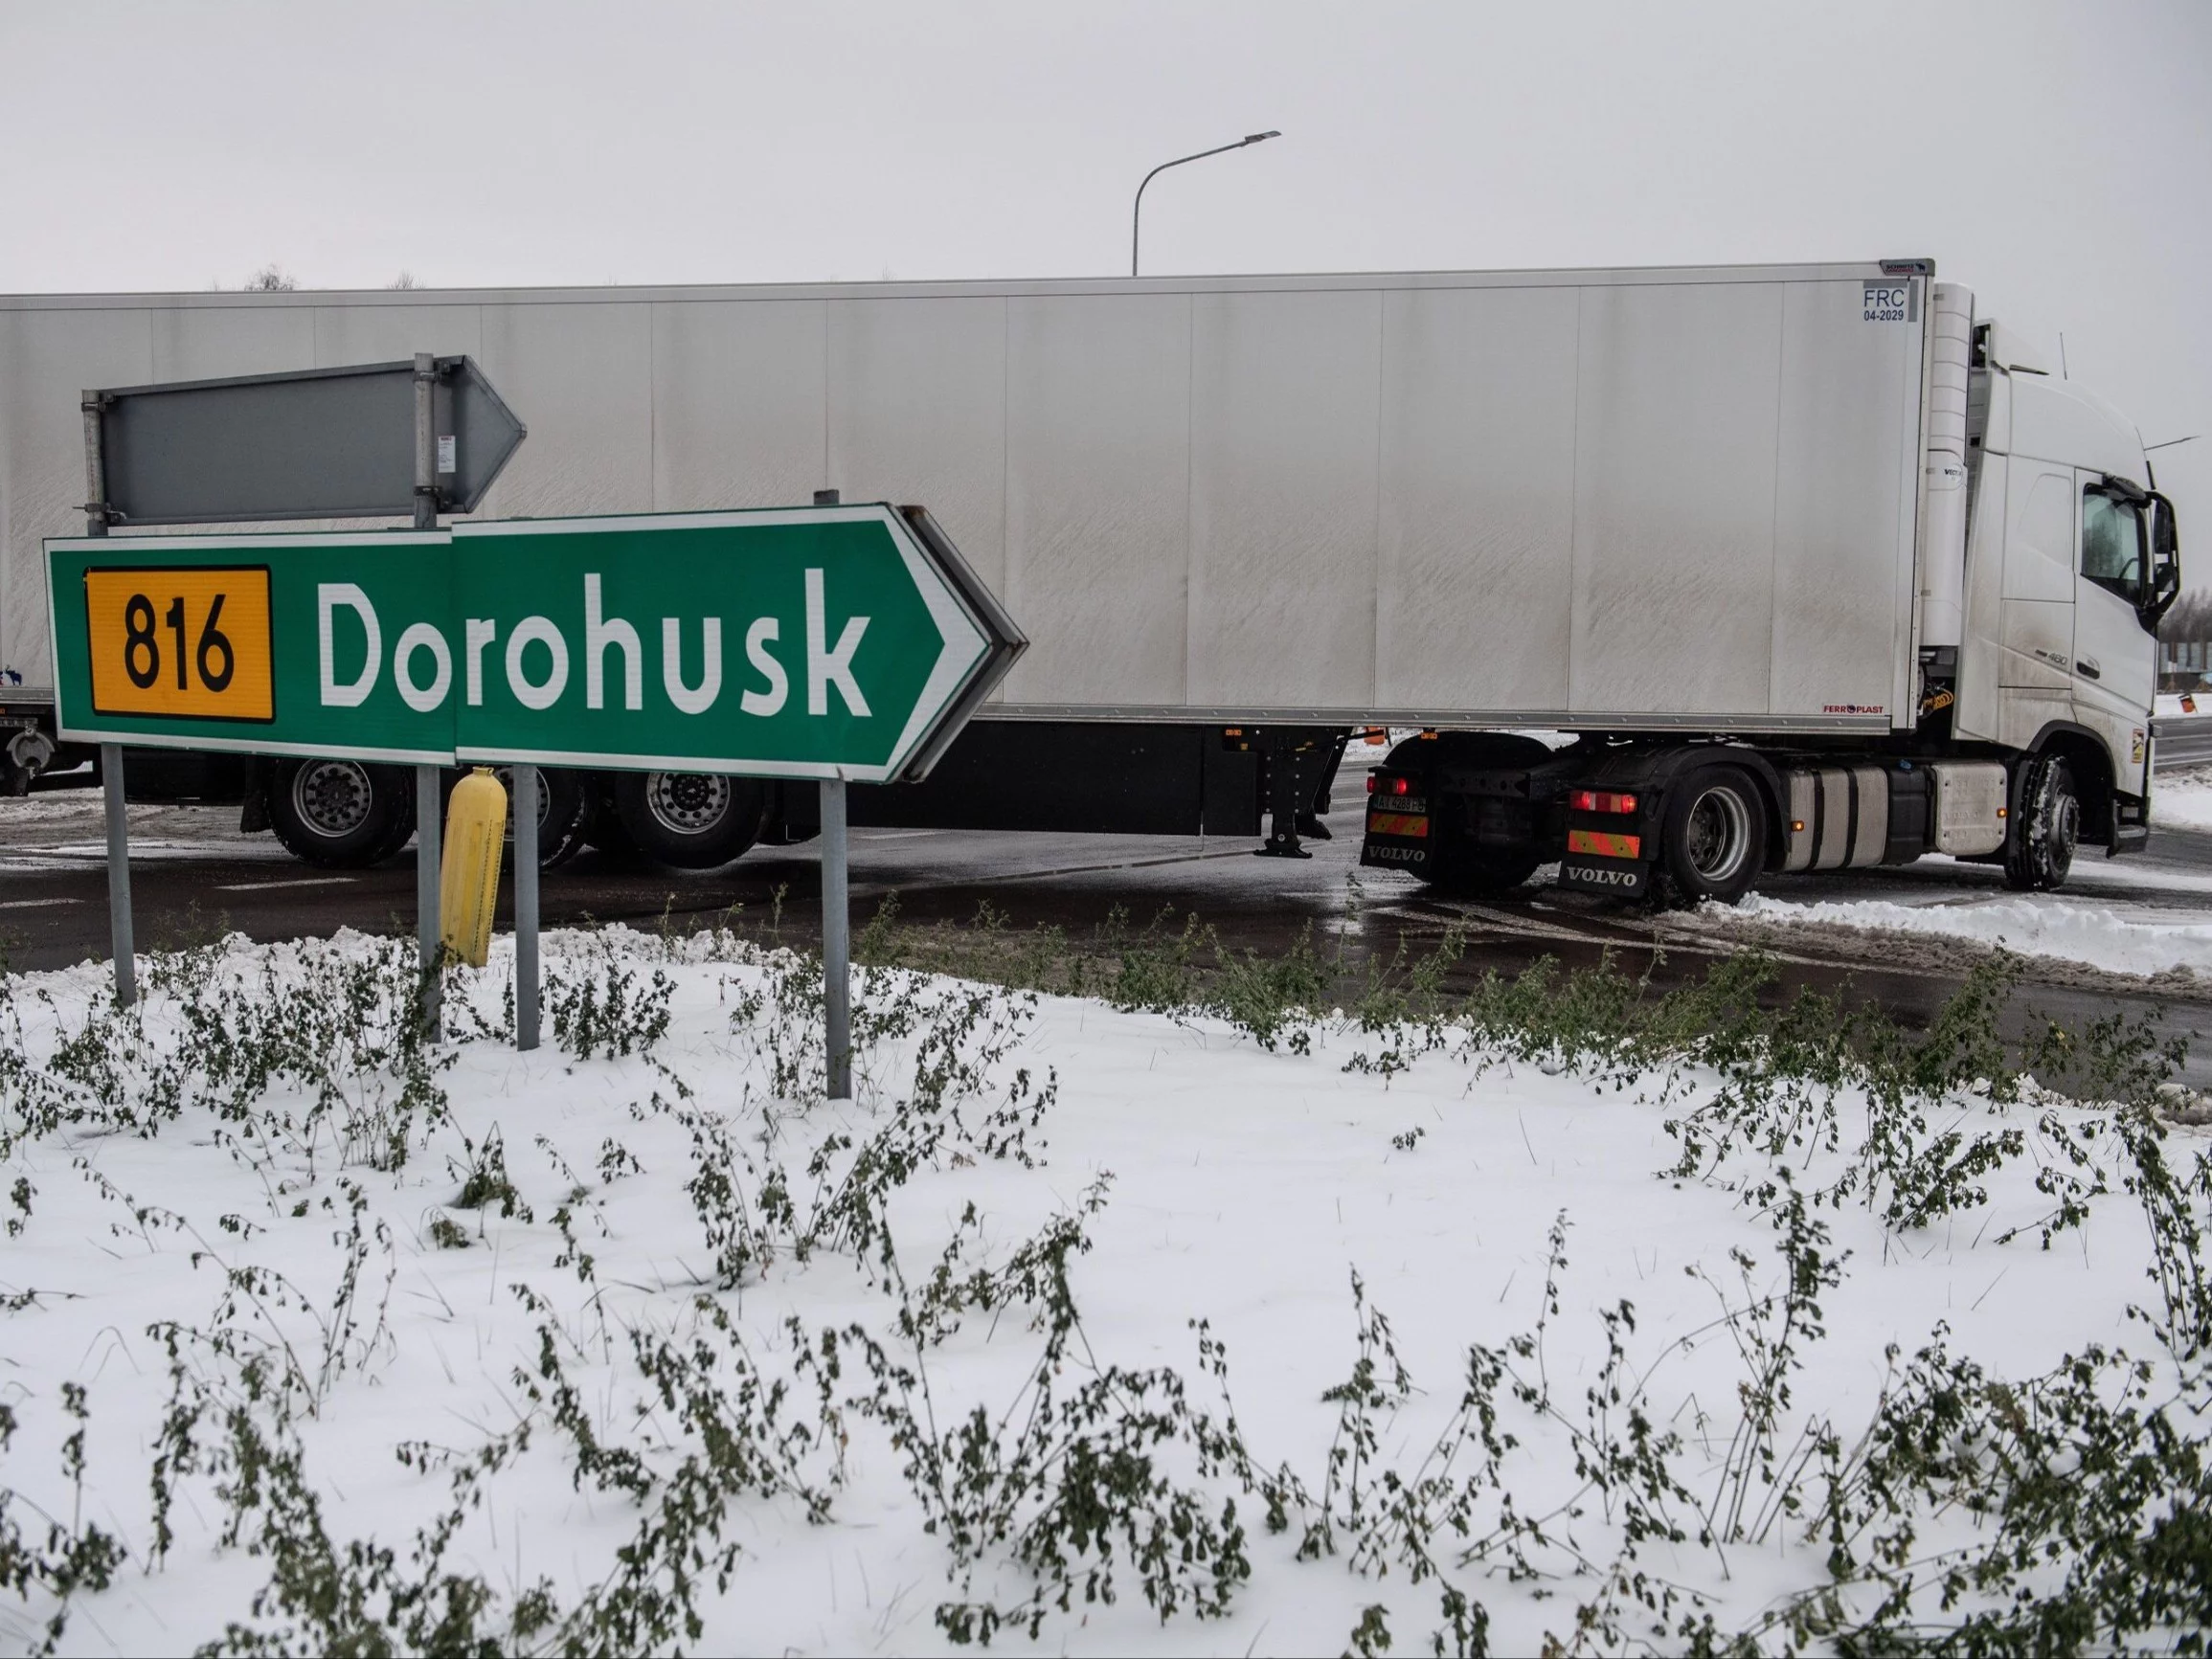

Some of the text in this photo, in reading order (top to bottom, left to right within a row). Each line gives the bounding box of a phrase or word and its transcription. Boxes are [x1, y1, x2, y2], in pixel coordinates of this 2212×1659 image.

[1863, 289, 1905, 307] FRC
[1863, 309, 1904, 322] 04-2029
[124, 594, 235, 693] 816
[317, 568, 872, 717] Dorohusk
[2048, 653, 2067, 665] 460
[1368, 845, 1426, 862] VOLVO
[1567, 866, 1637, 886] VOLVO
